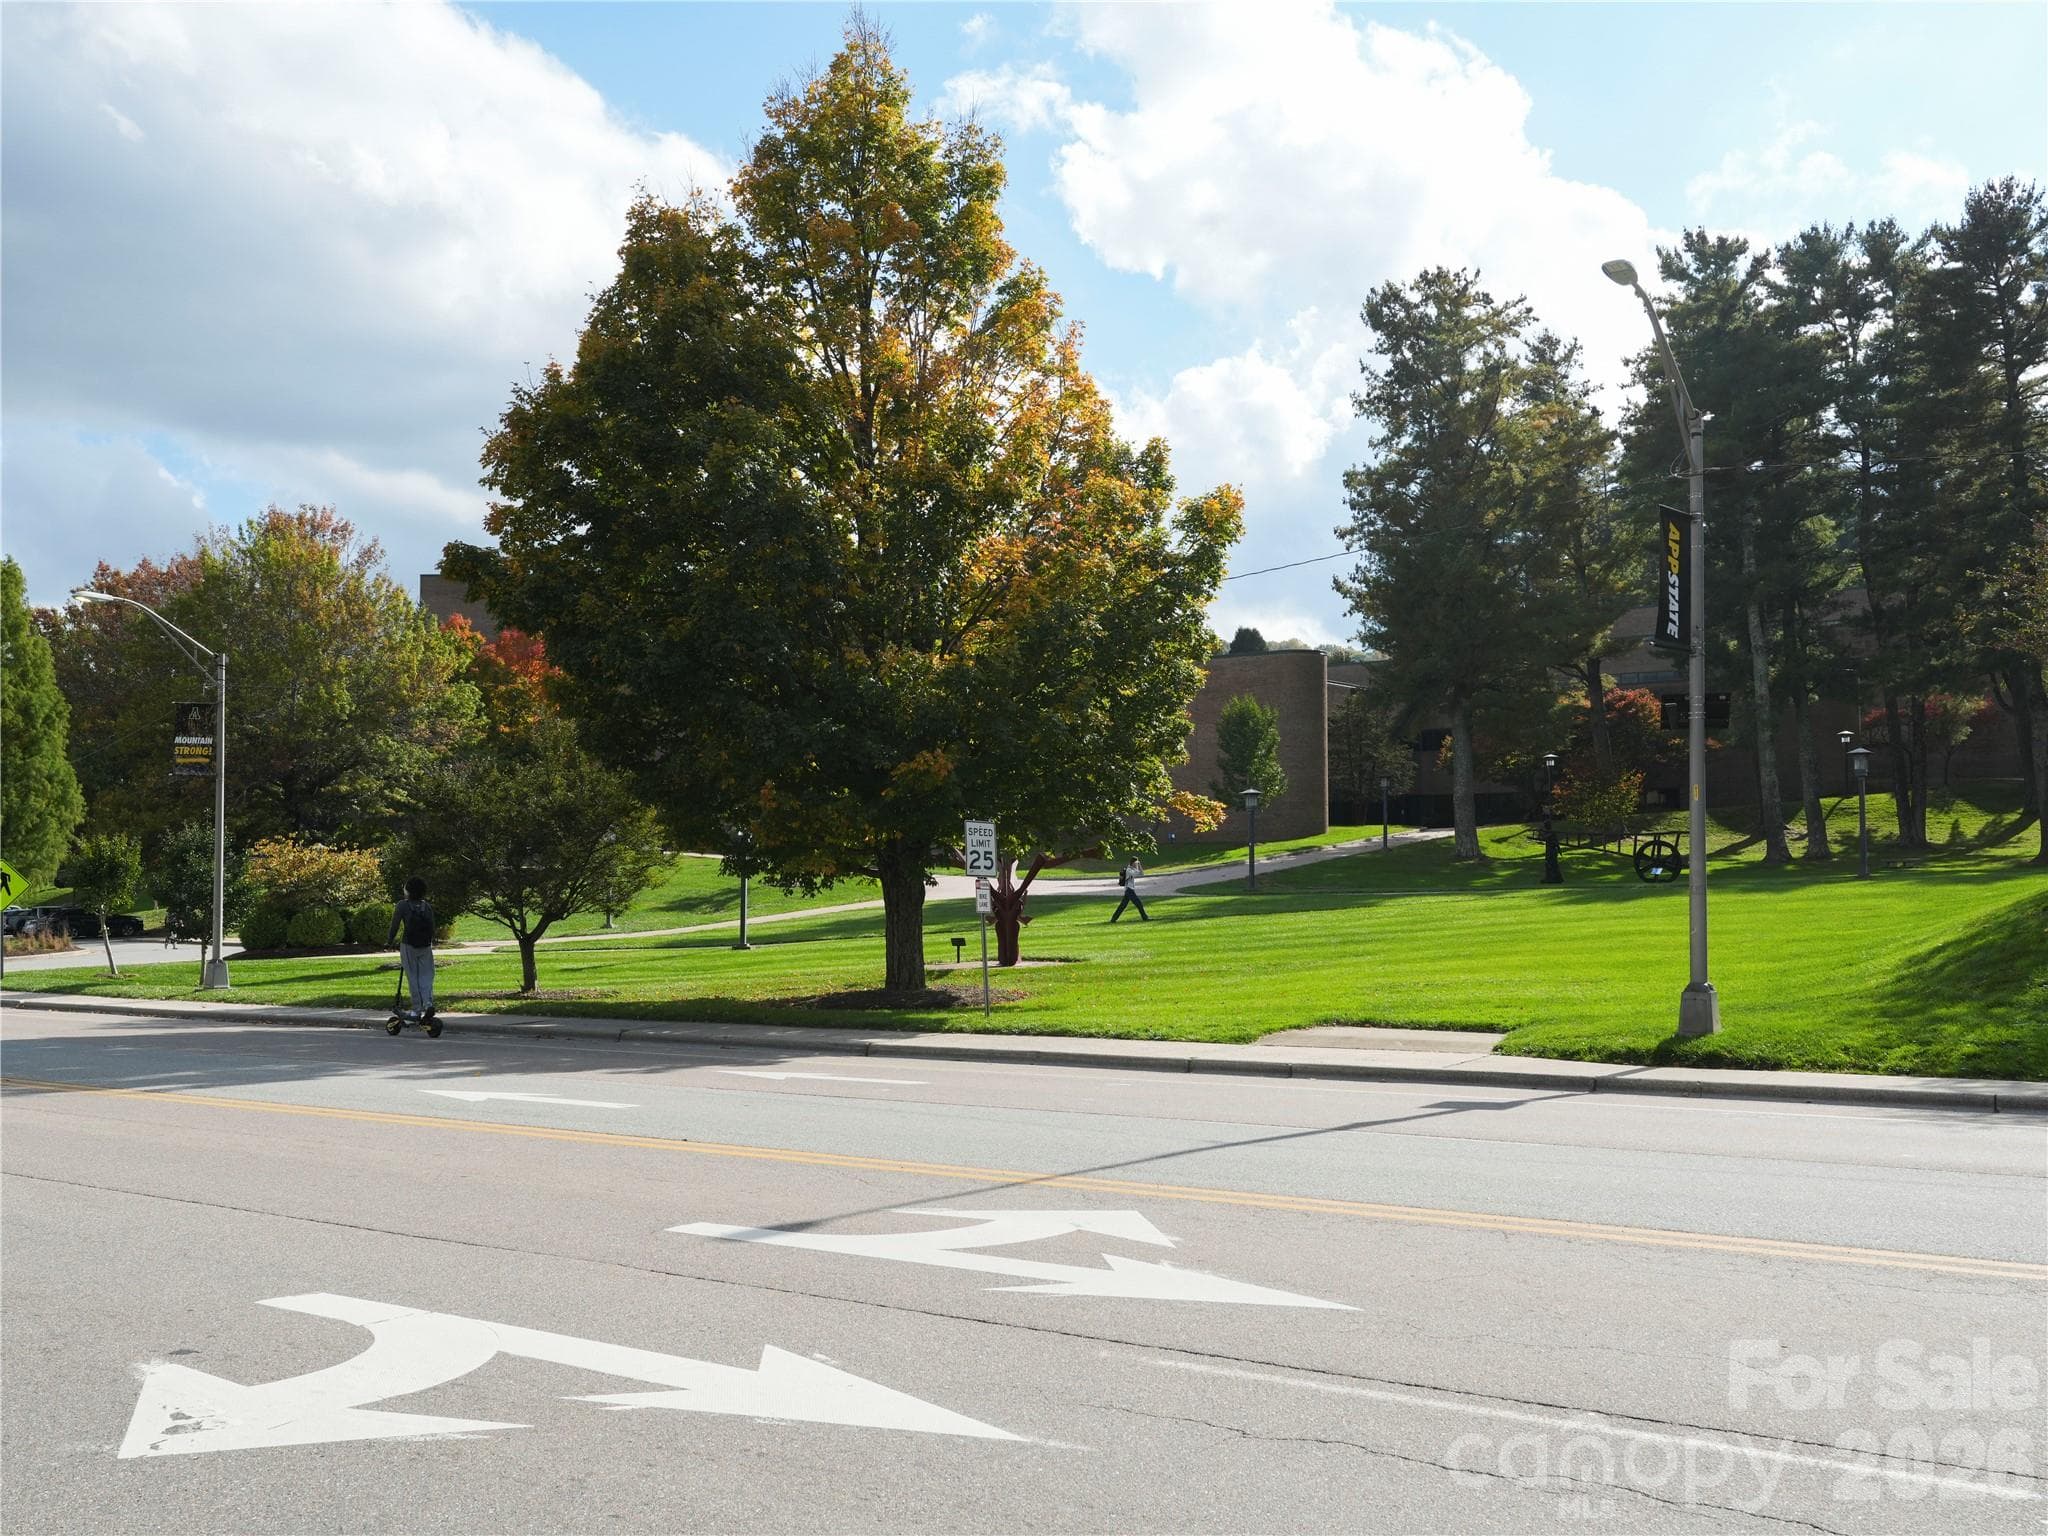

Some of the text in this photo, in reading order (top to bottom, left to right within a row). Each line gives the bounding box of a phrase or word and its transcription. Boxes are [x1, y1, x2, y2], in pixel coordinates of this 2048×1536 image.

[174, 736, 213, 745] MOUNTAIN
[174, 746, 213, 755] STRONG!
[968, 827, 993, 837] SPEED
[971, 839, 991, 848] LIMIT
[969, 850, 994, 870] 25
